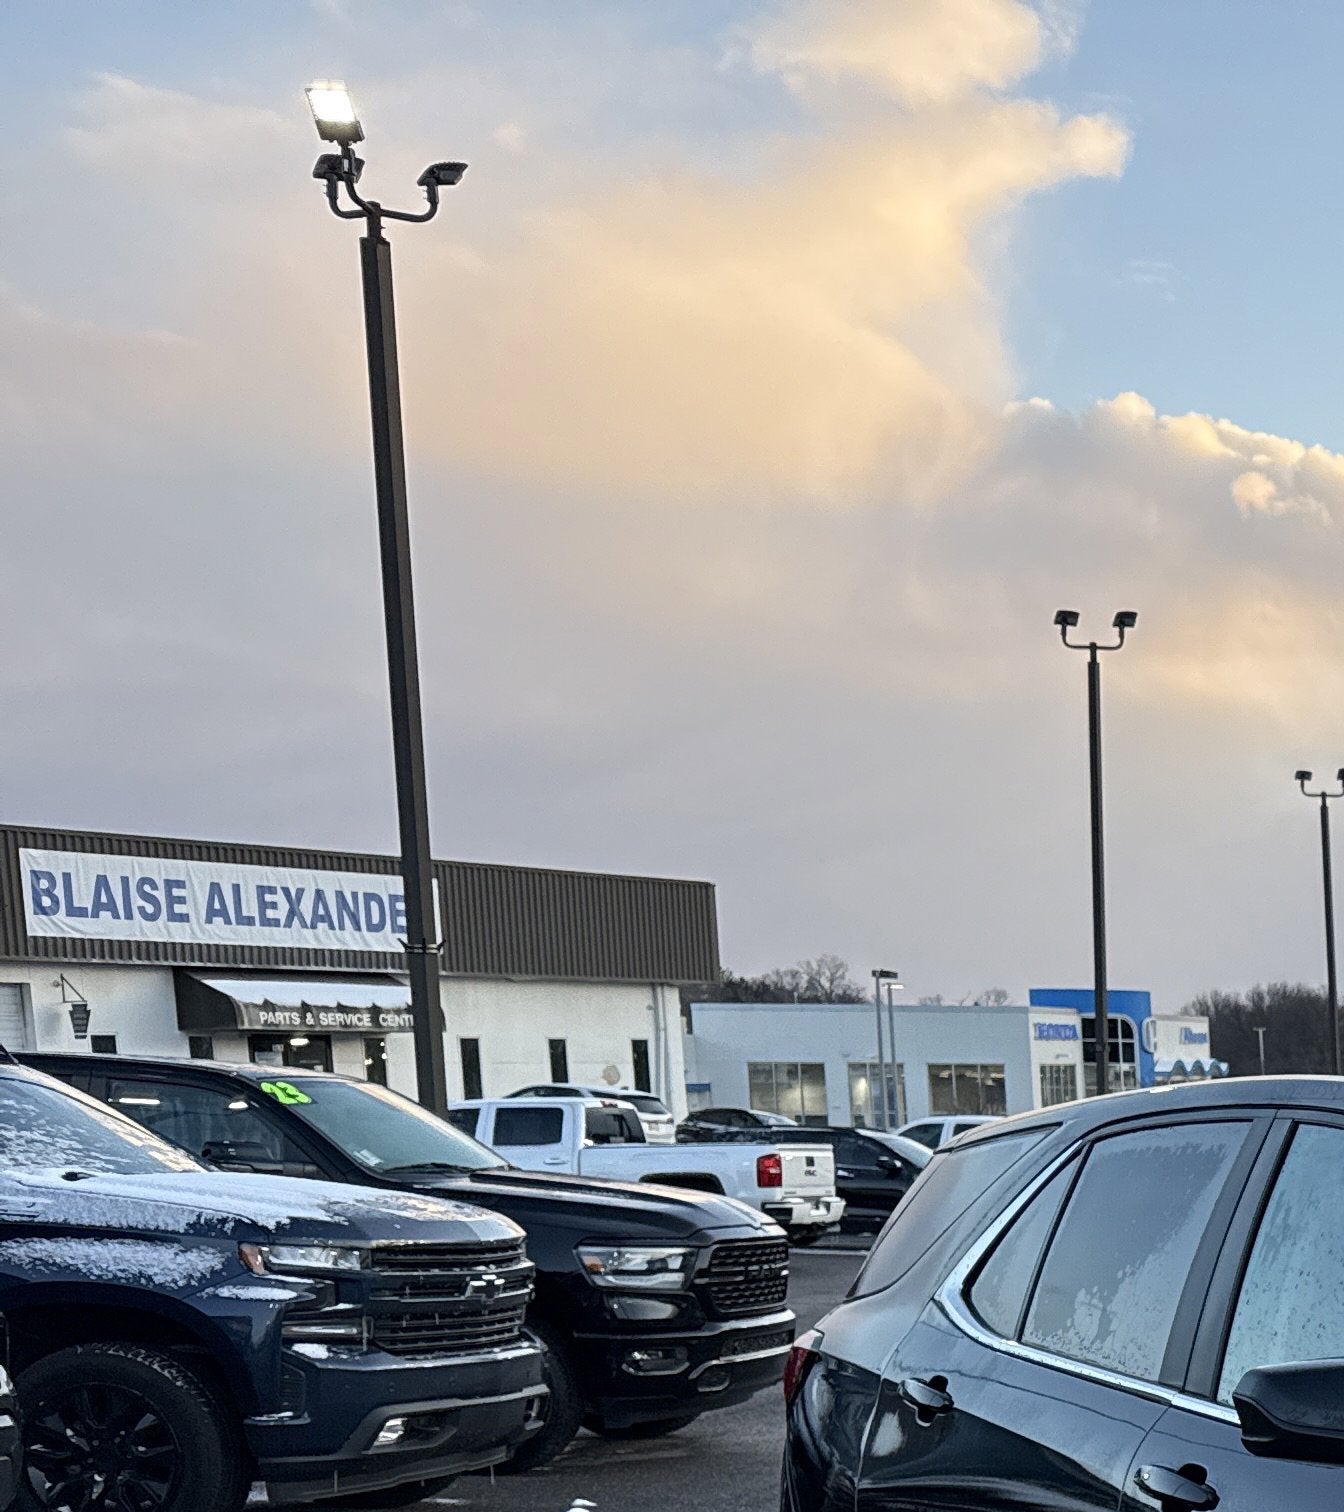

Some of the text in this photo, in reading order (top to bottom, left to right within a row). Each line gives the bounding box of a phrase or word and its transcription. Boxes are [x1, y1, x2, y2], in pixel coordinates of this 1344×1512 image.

[29, 869, 408, 935] BLAISE ALEXANDE
[258, 1011, 414, 1027] PARTS & SERVICE CENT
[260, 1081, 312, 1105] 23
